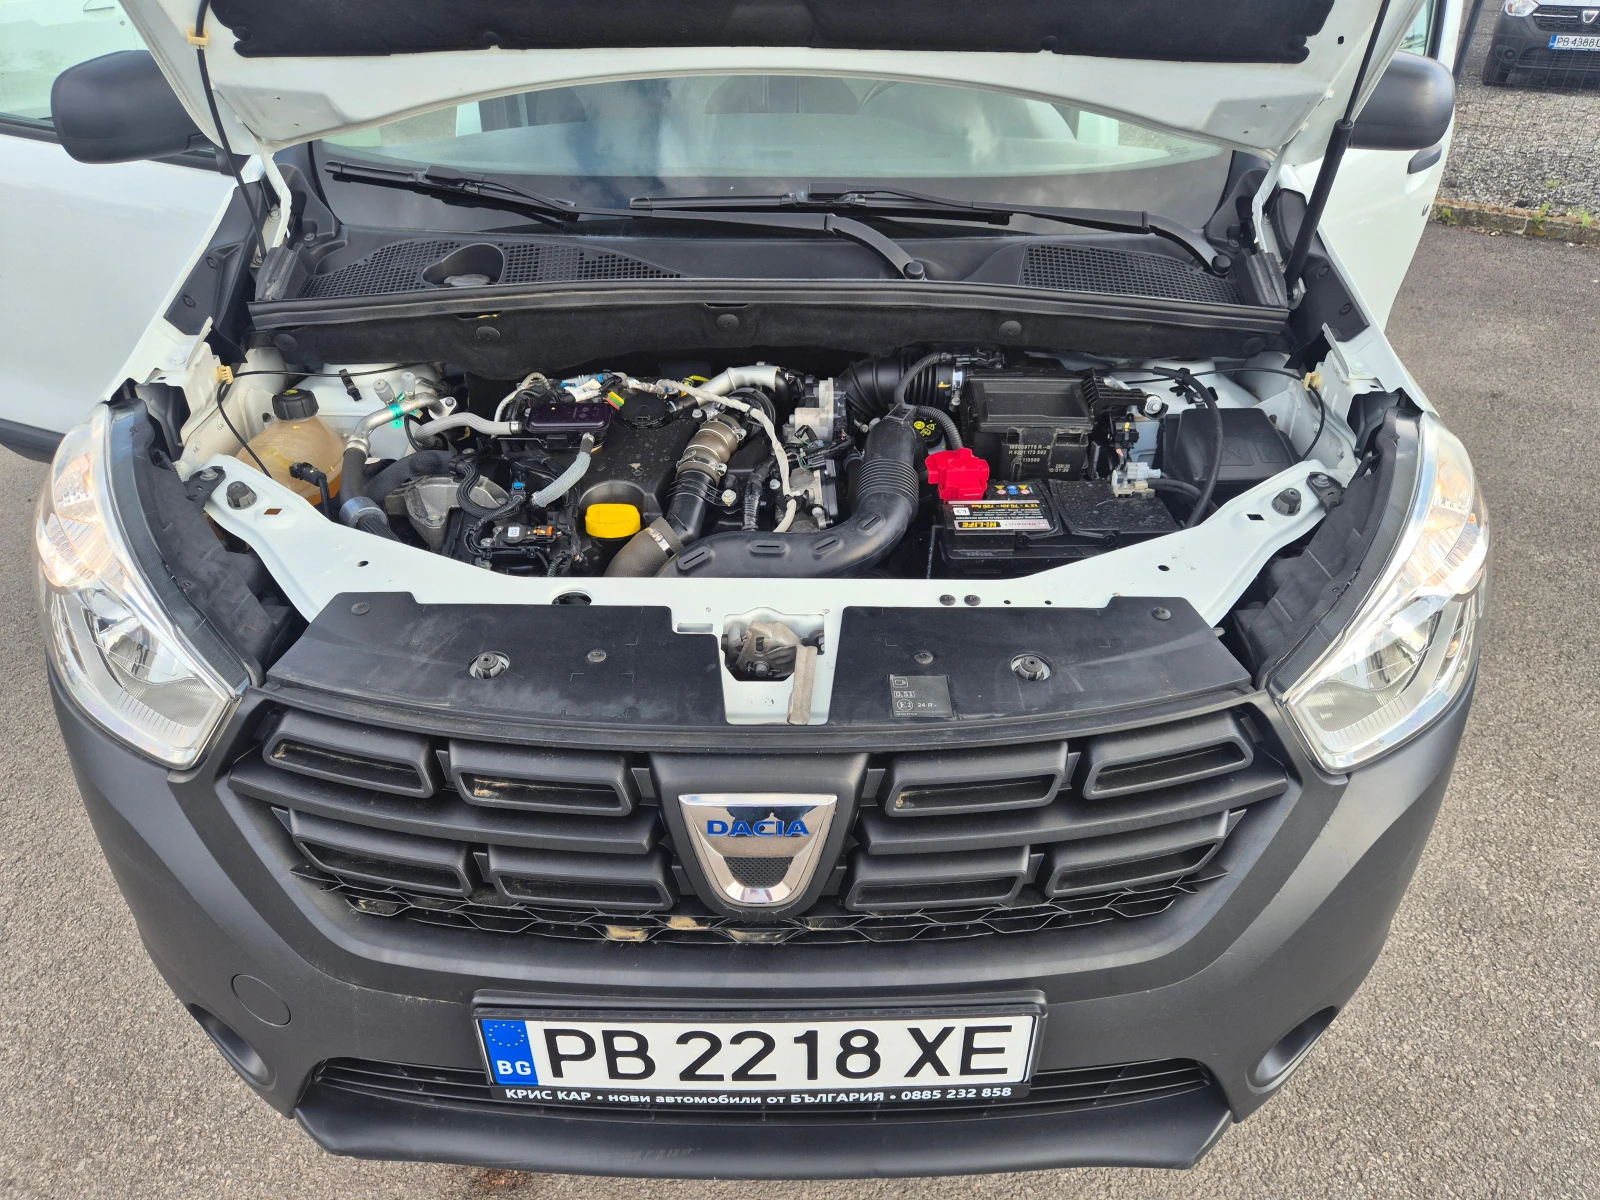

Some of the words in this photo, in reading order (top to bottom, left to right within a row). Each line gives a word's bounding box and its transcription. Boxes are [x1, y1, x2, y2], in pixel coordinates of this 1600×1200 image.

[706, 820, 810, 837] DACIA
[543, 1028, 656, 1080] PB
[675, 1028, 881, 1082] 2218
[903, 1025, 1013, 1077] XE
[496, 1060, 532, 1075] BG
[505, 1088, 552, 1100] КРИС
[557, 1091, 591, 1101] КАР
[608, 1093, 651, 1103] нови
[655, 1094, 762, 1104] автомобили
[766, 1095, 786, 1104] от
[790, 1092, 885, 1104] БЪЛГАРИЯ
[901, 1089, 942, 1100] 0885
[946, 1088, 977, 1099] 232
[981, 1087, 1012, 1098] 858
